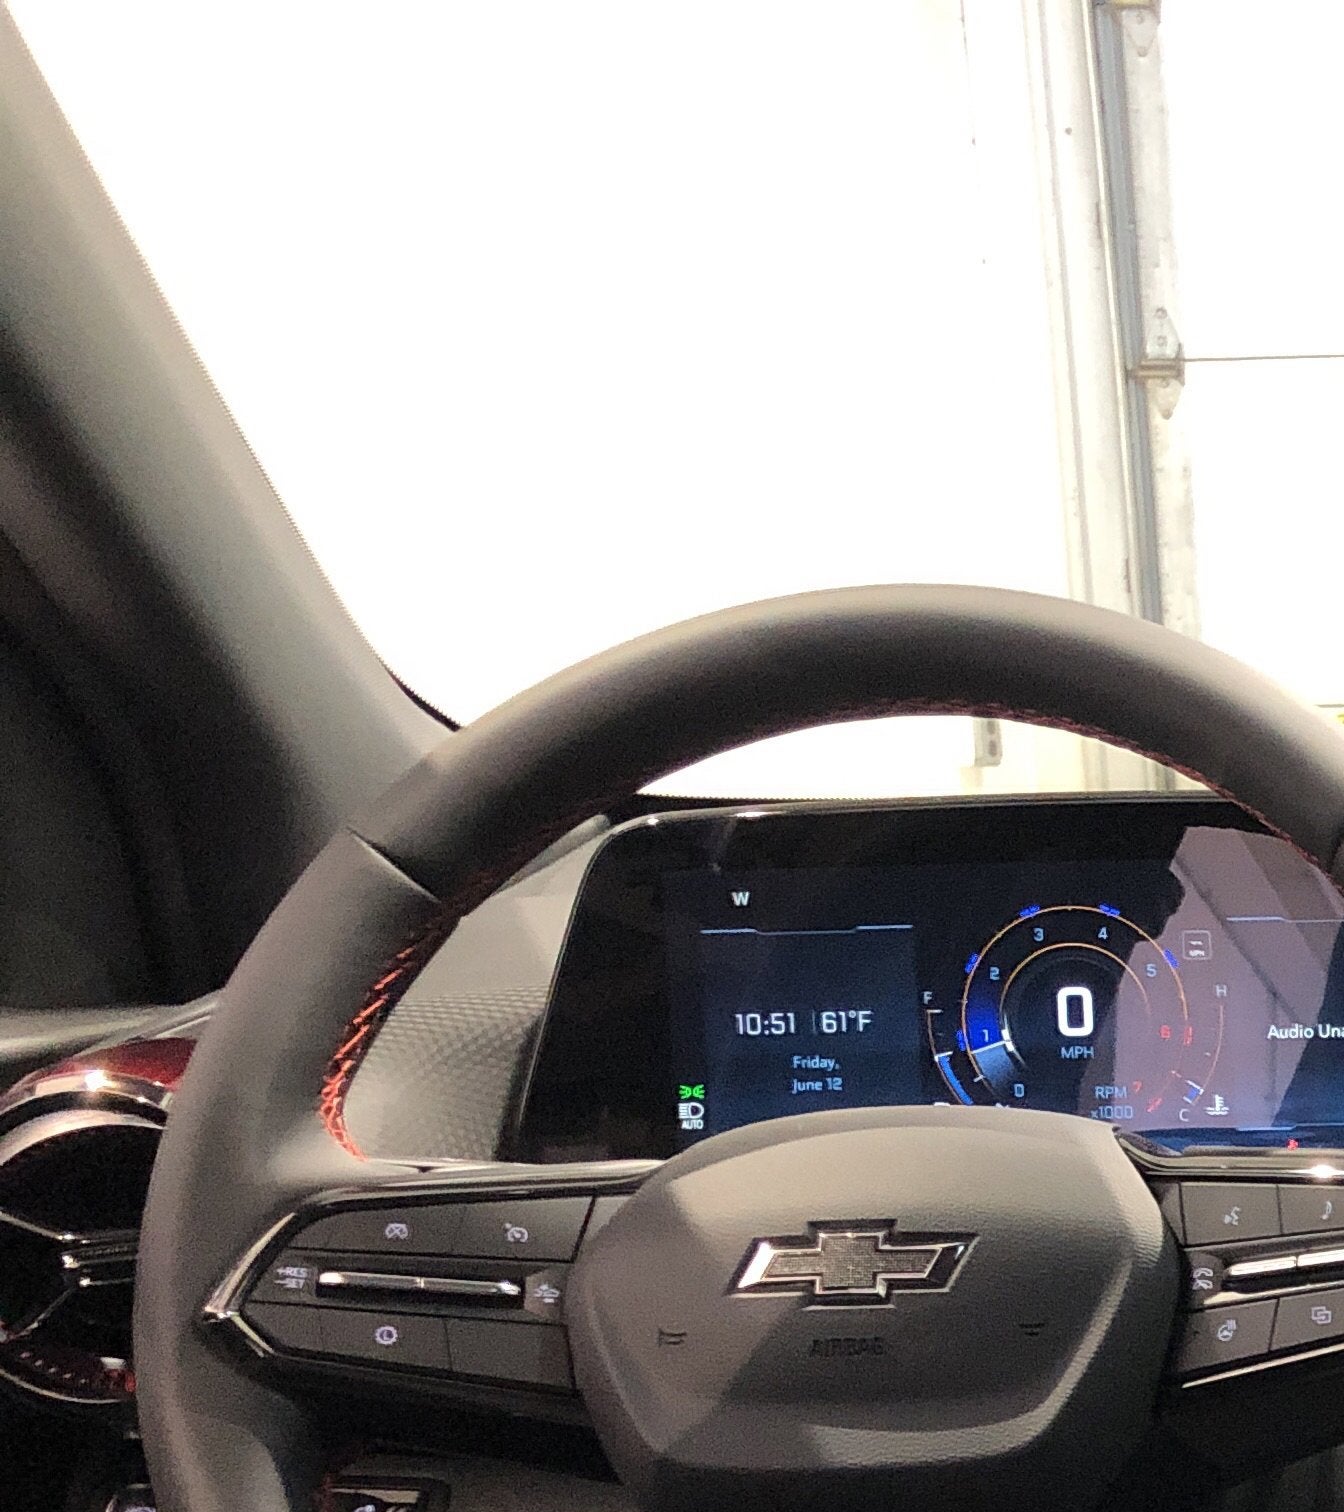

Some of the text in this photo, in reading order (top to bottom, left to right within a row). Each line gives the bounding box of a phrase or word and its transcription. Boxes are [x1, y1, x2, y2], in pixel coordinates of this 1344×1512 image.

[731, 891, 750, 906] W
[1033, 928, 1044, 941] 3
[1098, 927, 1108, 940] 4
[989, 967, 1000, 981] 2
[1146, 963, 1157, 978] 5
[1056, 986, 1094, 1037] 0
[735, 1012, 795, 1036] 10:51
[1267, 1023, 1314, 1039] Audio
[1061, 1046, 1094, 1059] MPH
[793, 1055, 839, 1072] Friday,
[826, 1077, 842, 1091] 12
[1095, 1086, 1127, 1099] RPM
[1091, 1105, 1133, 1120] x1000
[681, 1120, 704, 1130] AUTO
